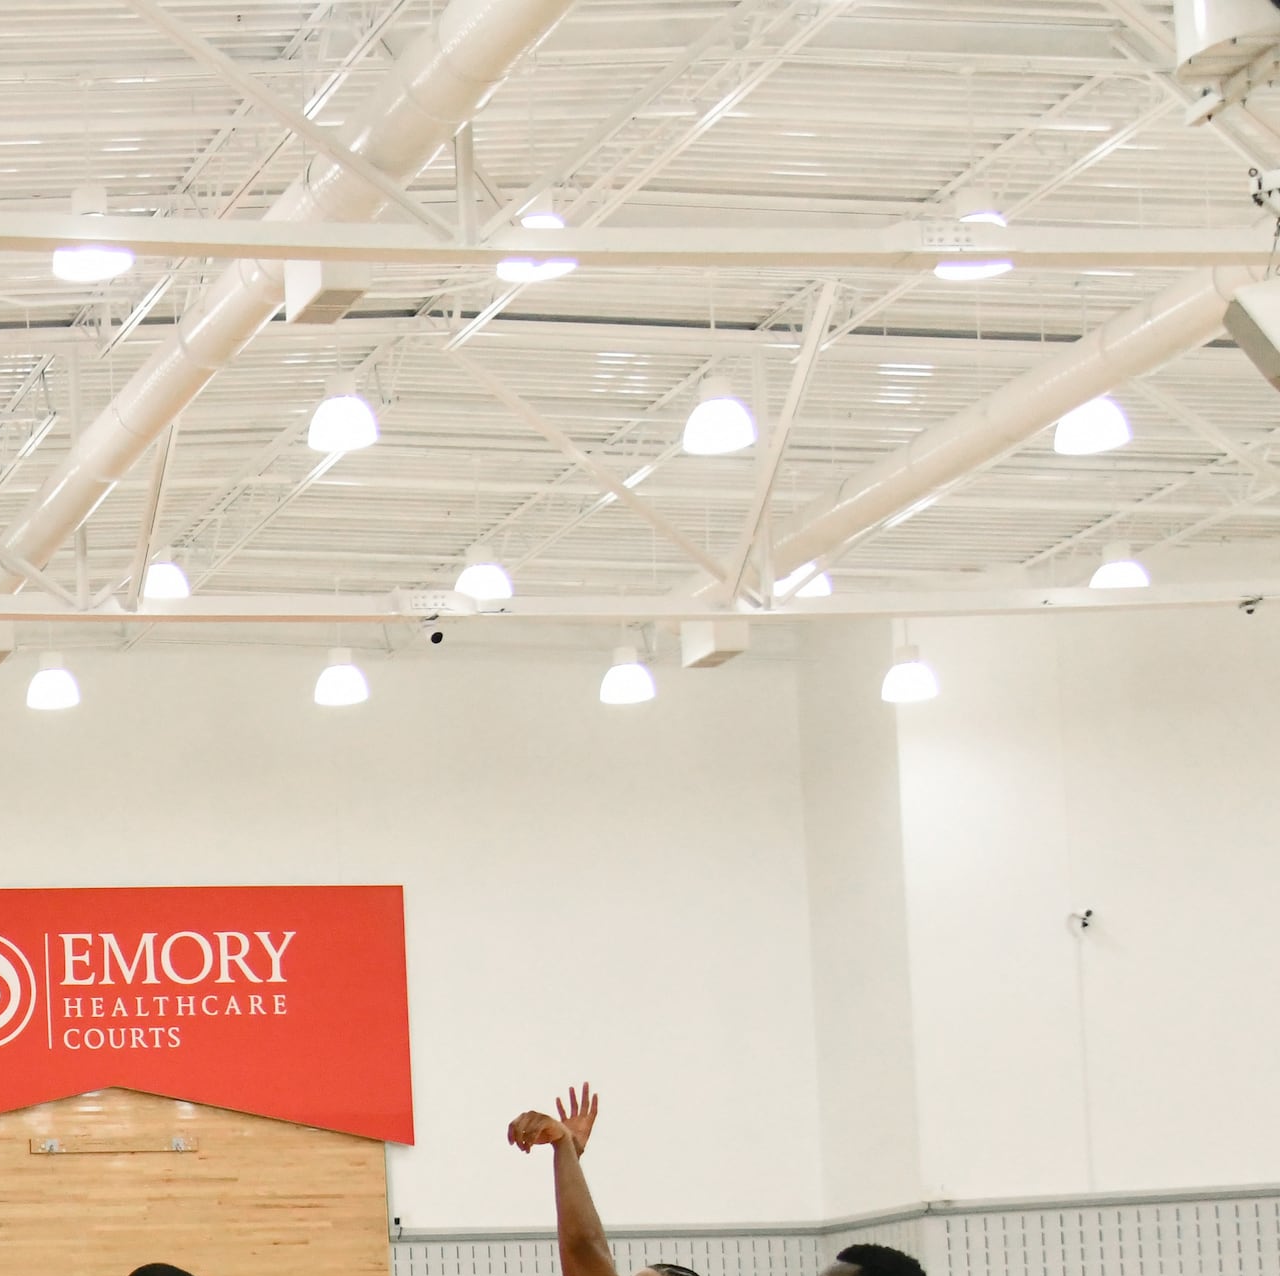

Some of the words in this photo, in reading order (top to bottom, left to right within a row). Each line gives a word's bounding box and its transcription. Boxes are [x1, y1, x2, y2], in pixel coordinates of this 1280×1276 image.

[57, 930, 297, 987] EMORY
[62, 994, 288, 1019] HEALTHCARE
[62, 1026, 182, 1051] COURTS
